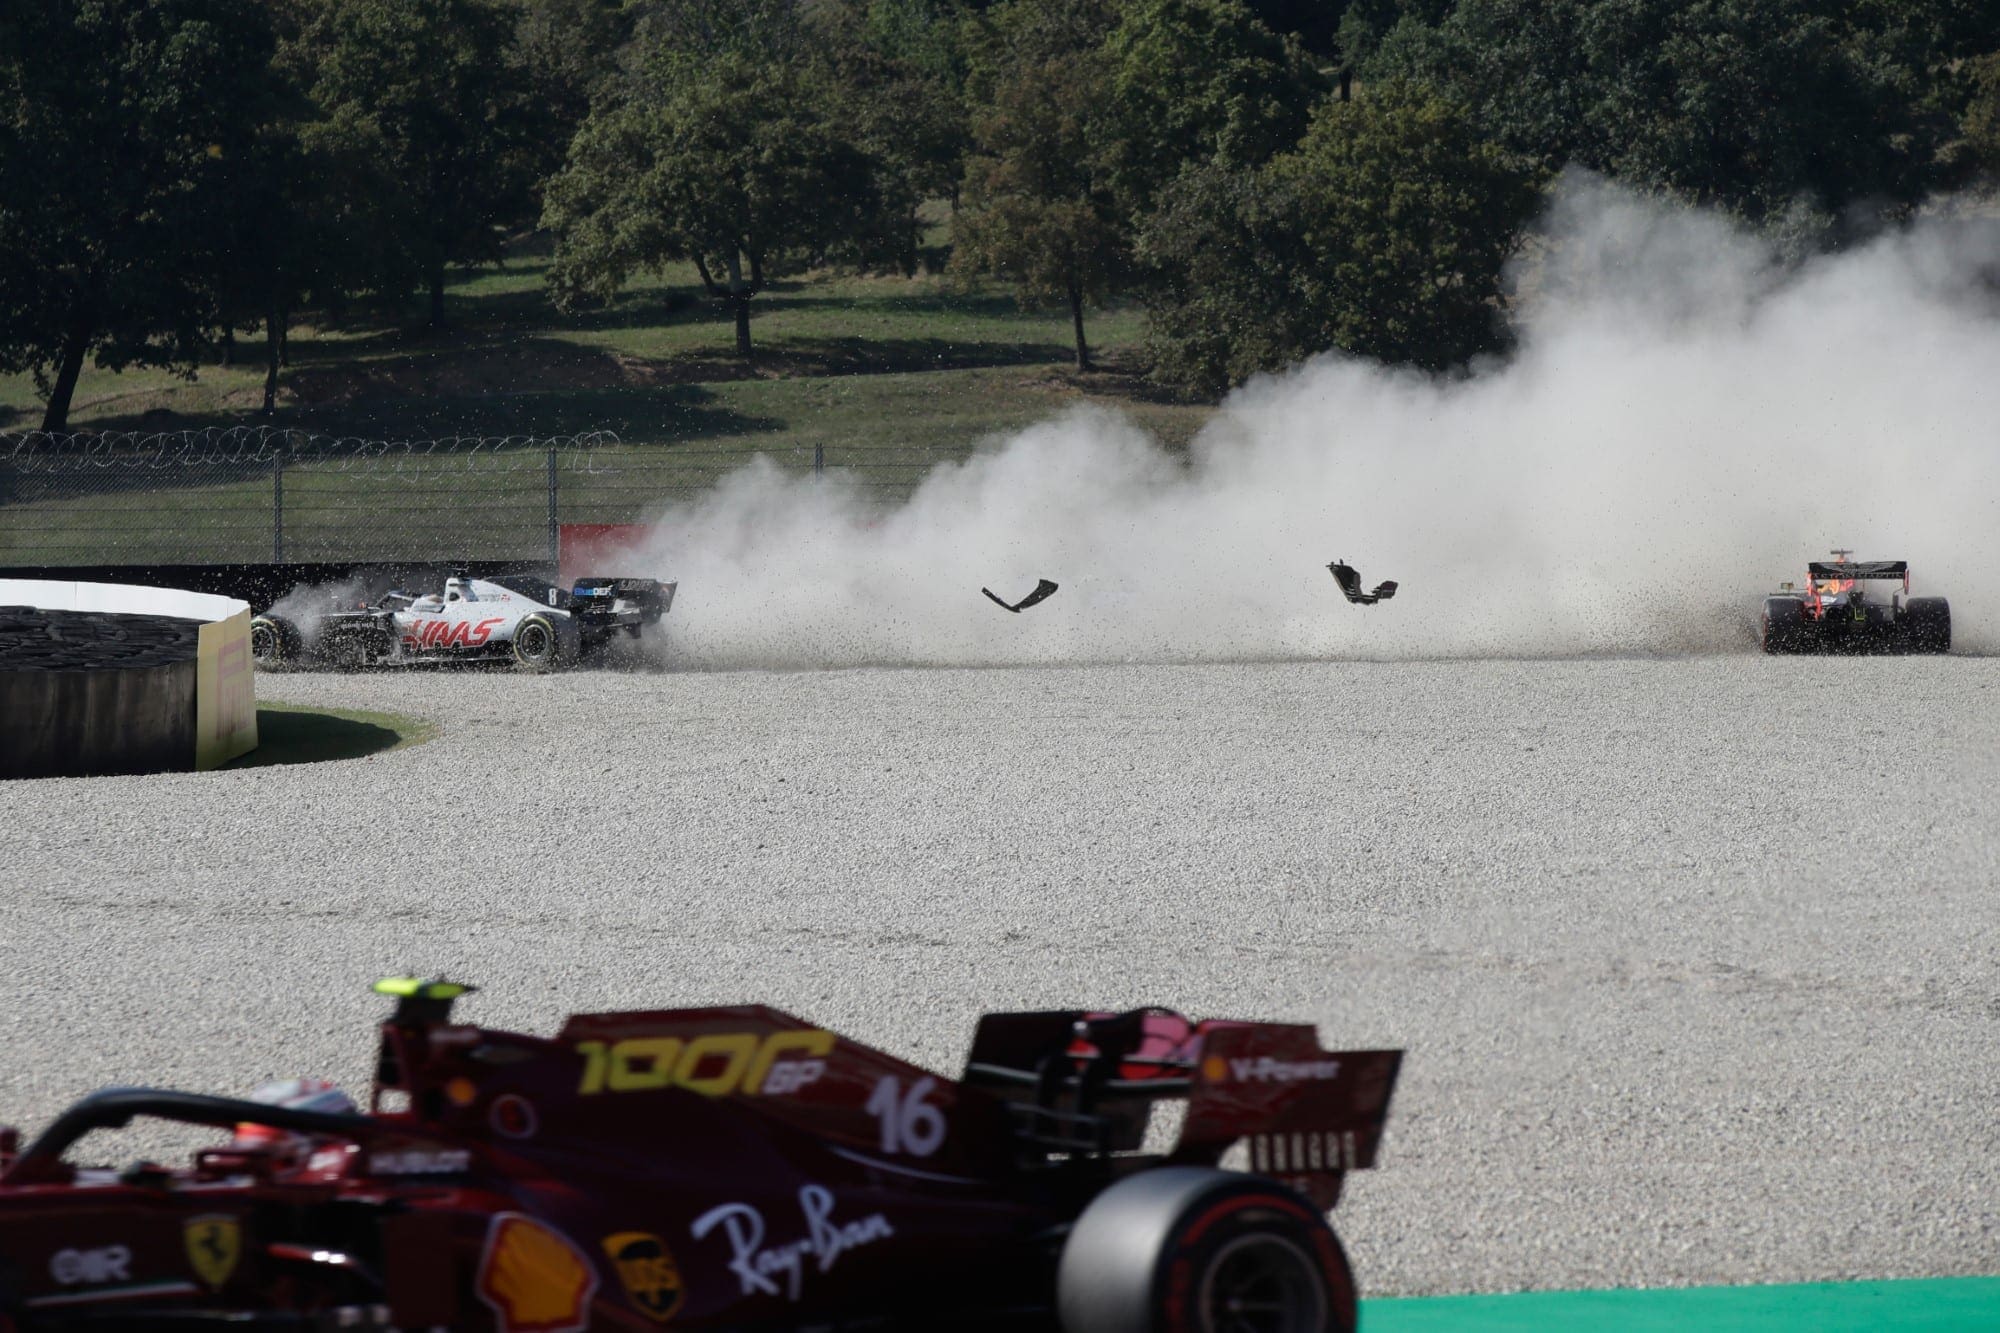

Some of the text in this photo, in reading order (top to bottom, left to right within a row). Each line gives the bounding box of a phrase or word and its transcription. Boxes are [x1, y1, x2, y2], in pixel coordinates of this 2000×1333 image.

[548, 588, 557, 605] 8
[402, 617, 505, 650] HAAS
[761, 1060, 827, 1095] GP
[1229, 1056, 1342, 1083] V-Power
[866, 1074, 946, 1157] 16
